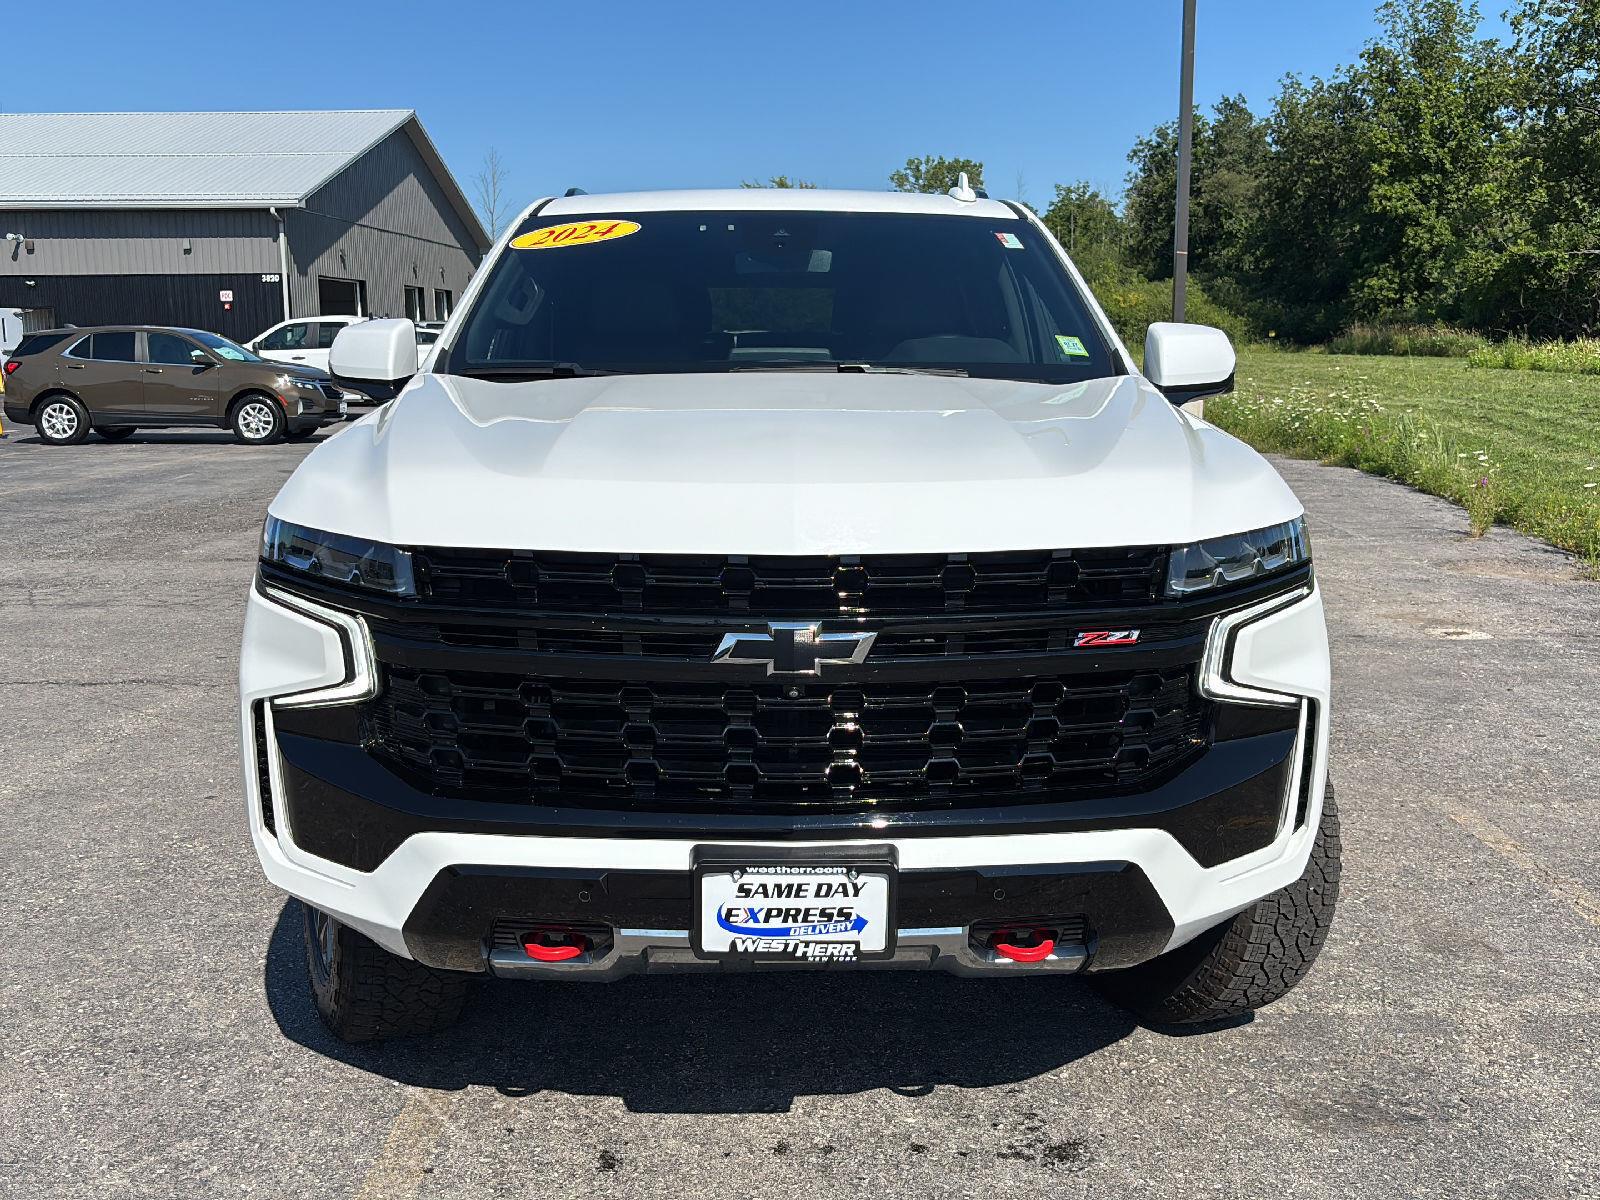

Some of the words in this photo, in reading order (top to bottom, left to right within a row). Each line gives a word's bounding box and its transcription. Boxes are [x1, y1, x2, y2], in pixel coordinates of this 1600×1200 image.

[528, 223, 621, 247] 2024
[1073, 629, 1141, 647] Z71
[745, 866, 848, 874] westherr.com
[735, 882, 811, 899] SAME
[813, 881, 868, 899] DAY
[724, 906, 855, 924] EXPRESS
[789, 920, 855, 937] DELIVERY
